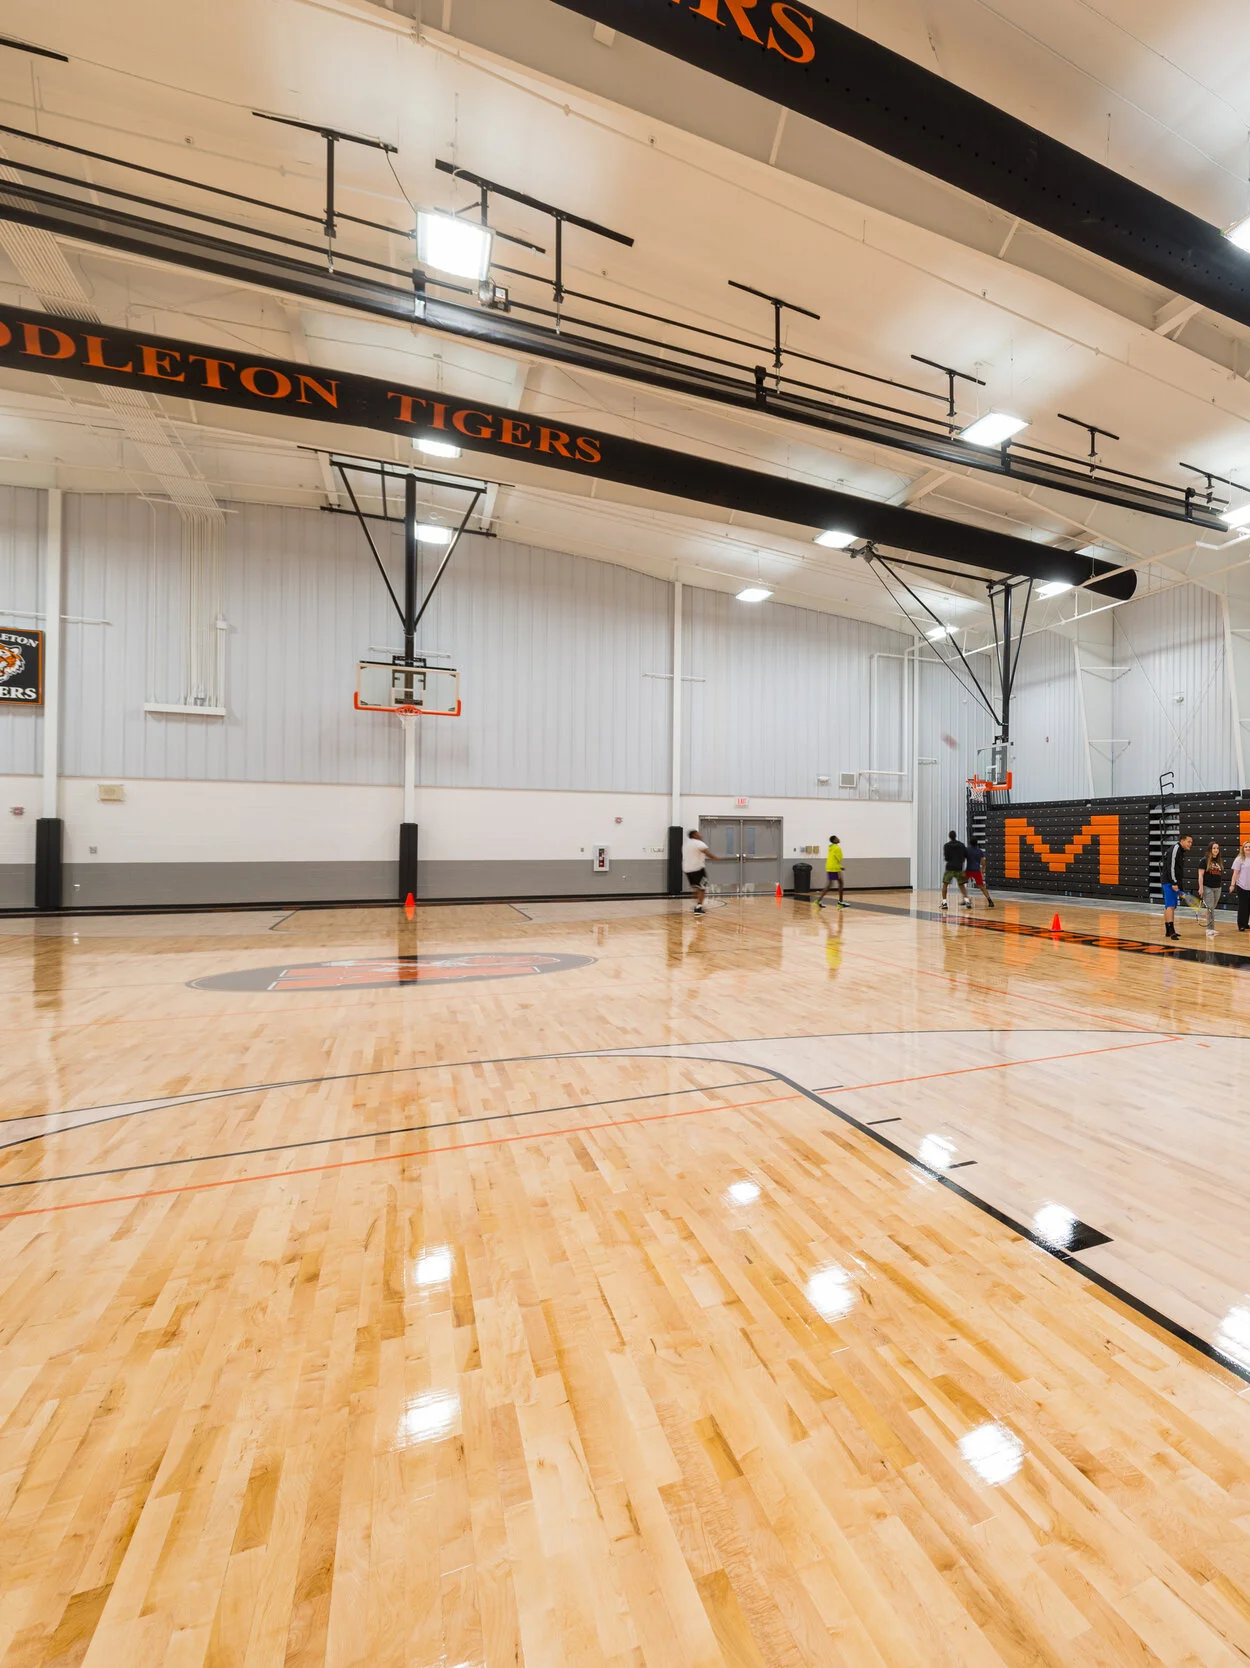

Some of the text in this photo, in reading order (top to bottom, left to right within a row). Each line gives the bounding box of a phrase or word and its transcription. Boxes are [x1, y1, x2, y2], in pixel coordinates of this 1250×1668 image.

[667, 0, 815, 64] RS
[0, 320, 602, 463] DLETON TIGERS
[0, 633, 39, 648] ETON
[1005, 815, 1119, 884] M
